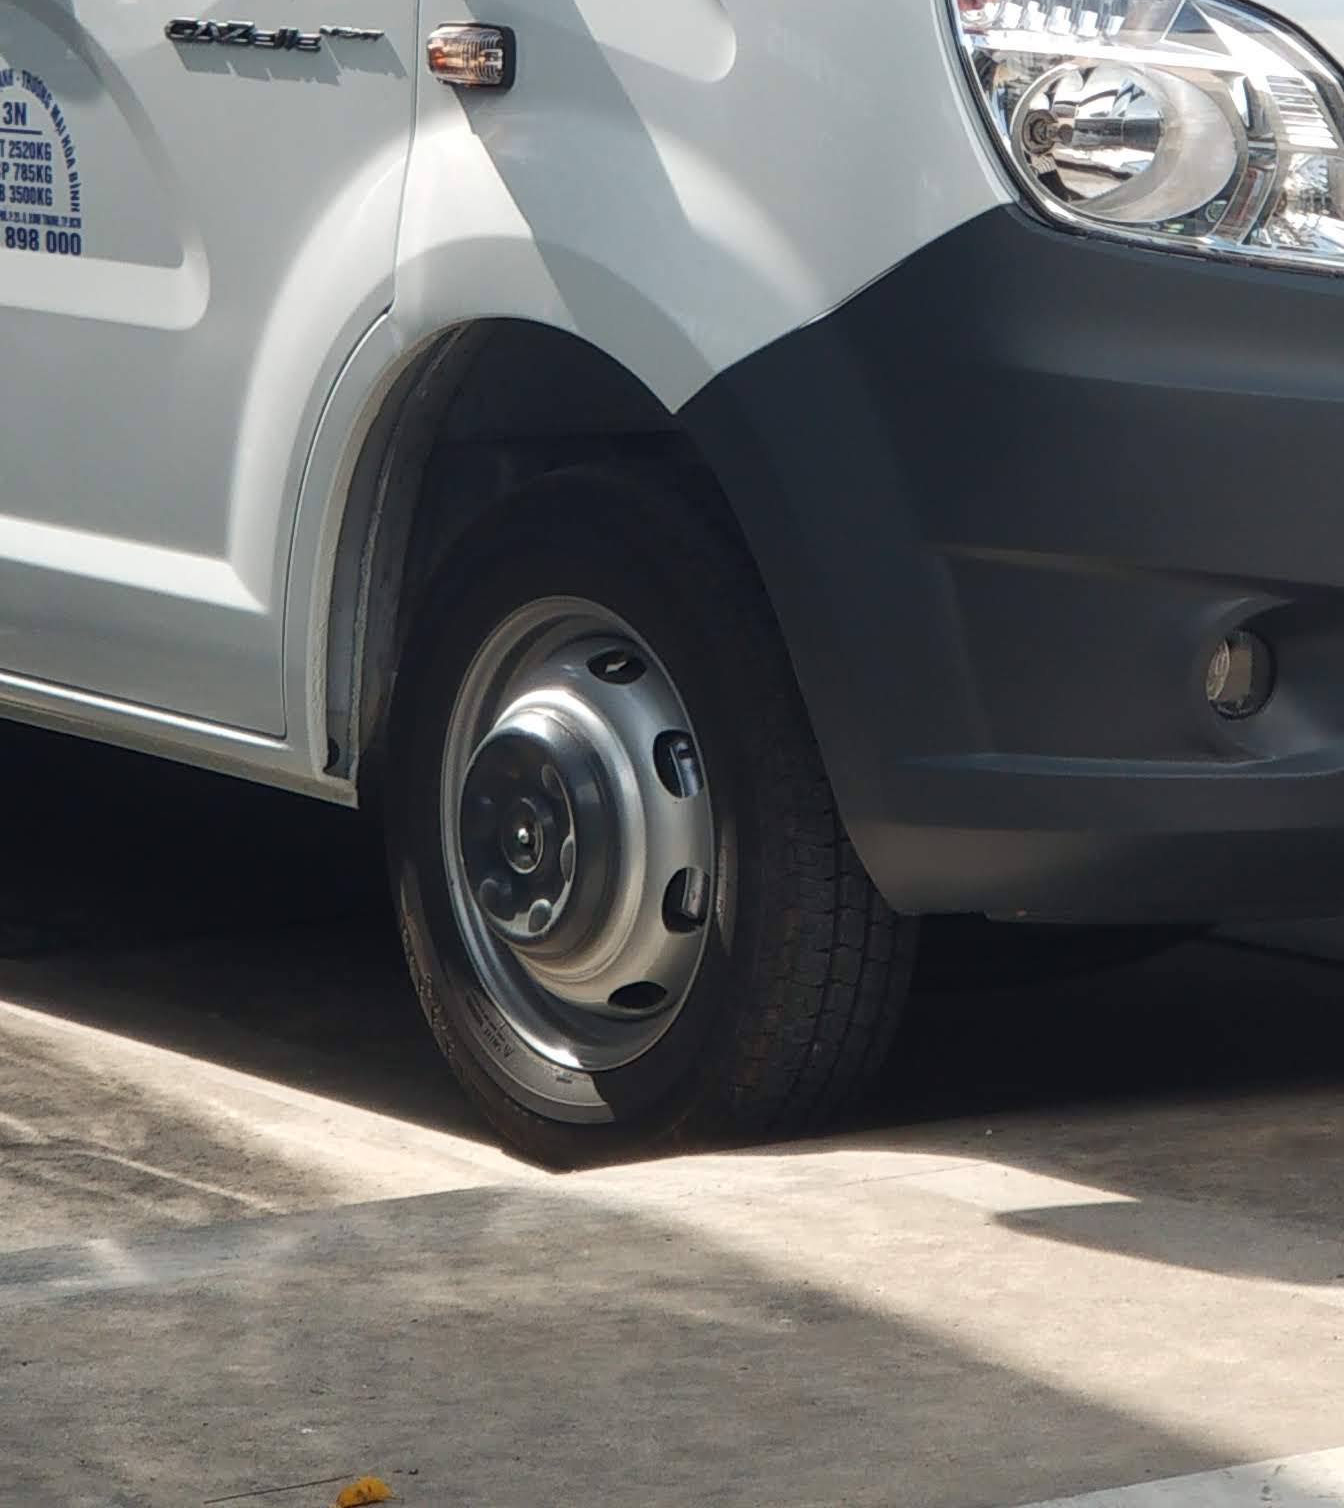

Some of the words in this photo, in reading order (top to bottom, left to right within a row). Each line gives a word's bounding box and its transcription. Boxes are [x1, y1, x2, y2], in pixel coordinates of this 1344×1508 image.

[2, 101, 27, 126] 3N
[8, 140, 52, 162] 2520KG
[13, 163, 53, 184] 785KG
[8, 184, 53, 206] 3500KG
[5, 226, 40, 251] 898
[46, 230, 82, 256] 000
